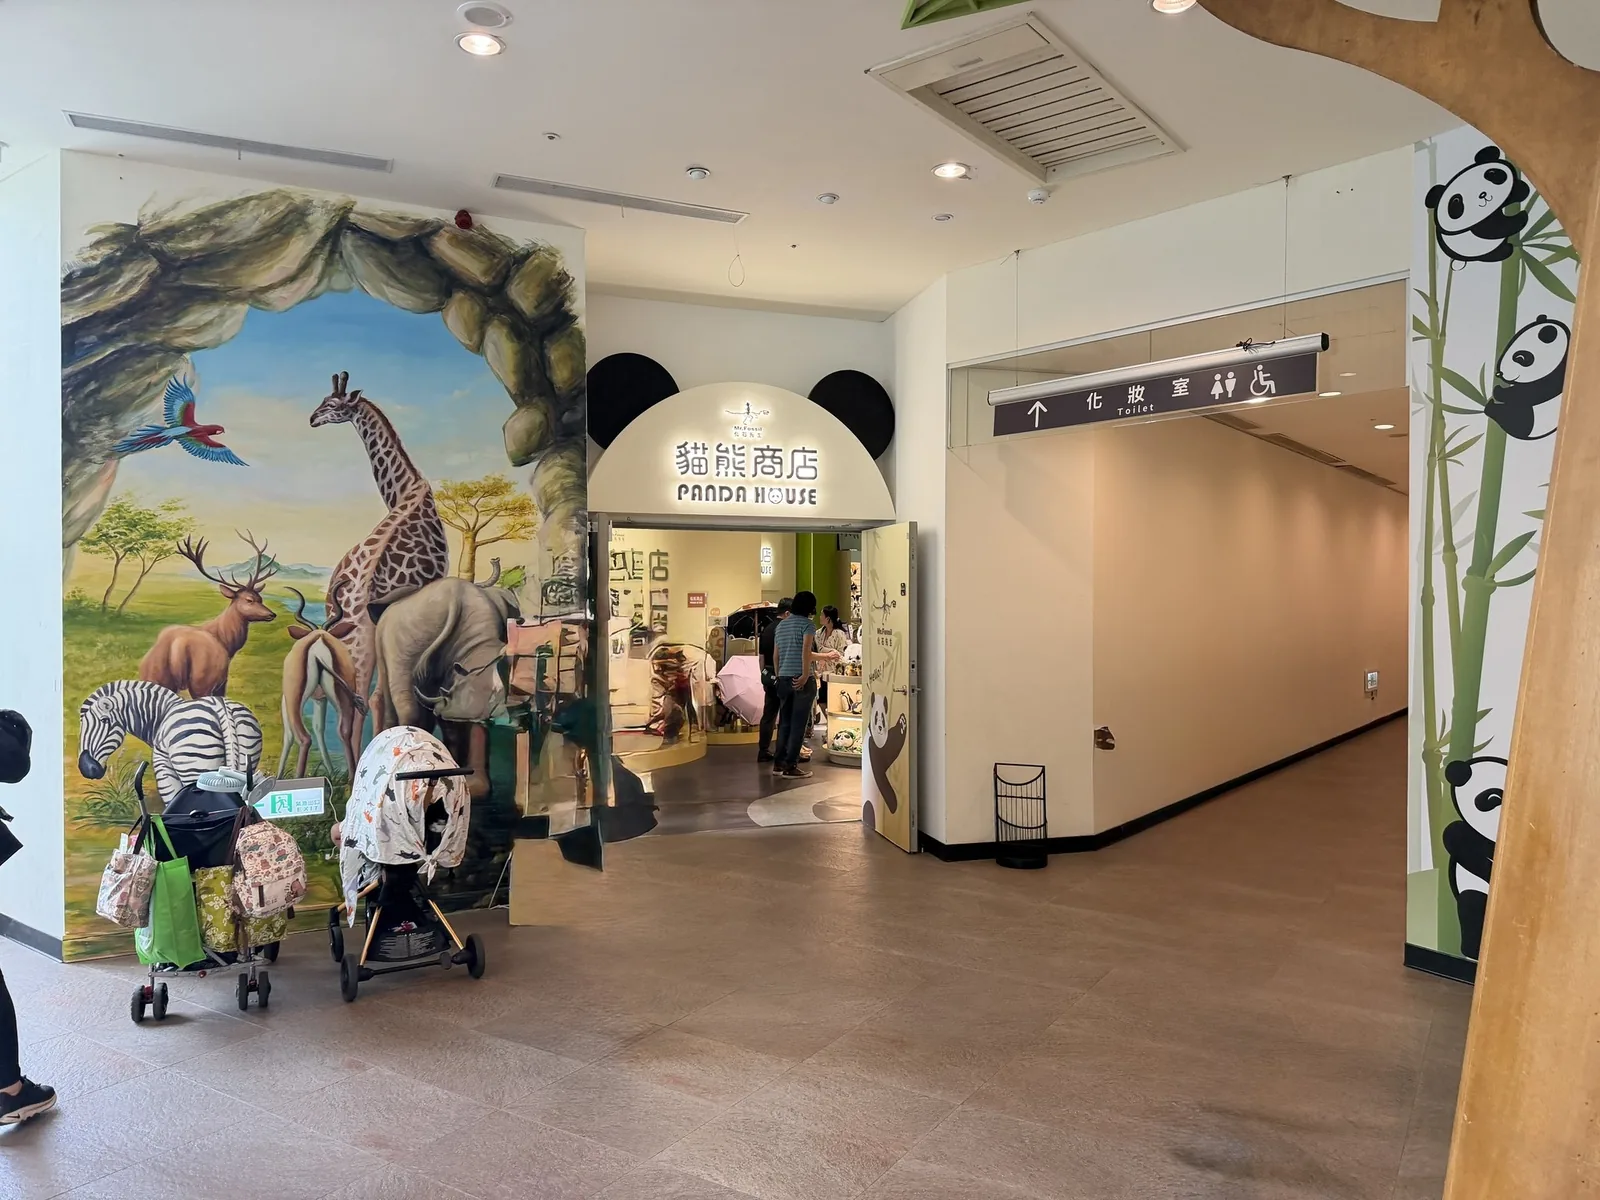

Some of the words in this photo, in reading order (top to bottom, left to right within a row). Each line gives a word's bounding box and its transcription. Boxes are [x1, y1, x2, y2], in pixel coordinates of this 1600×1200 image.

[1086, 377, 1190, 411] 化妝室
[1117, 403, 1154, 416] Toilet
[675, 441, 818, 480] 貓熊商店
[677, 483, 747, 503] PANDA
[754, 487, 817, 505] HOUSE
